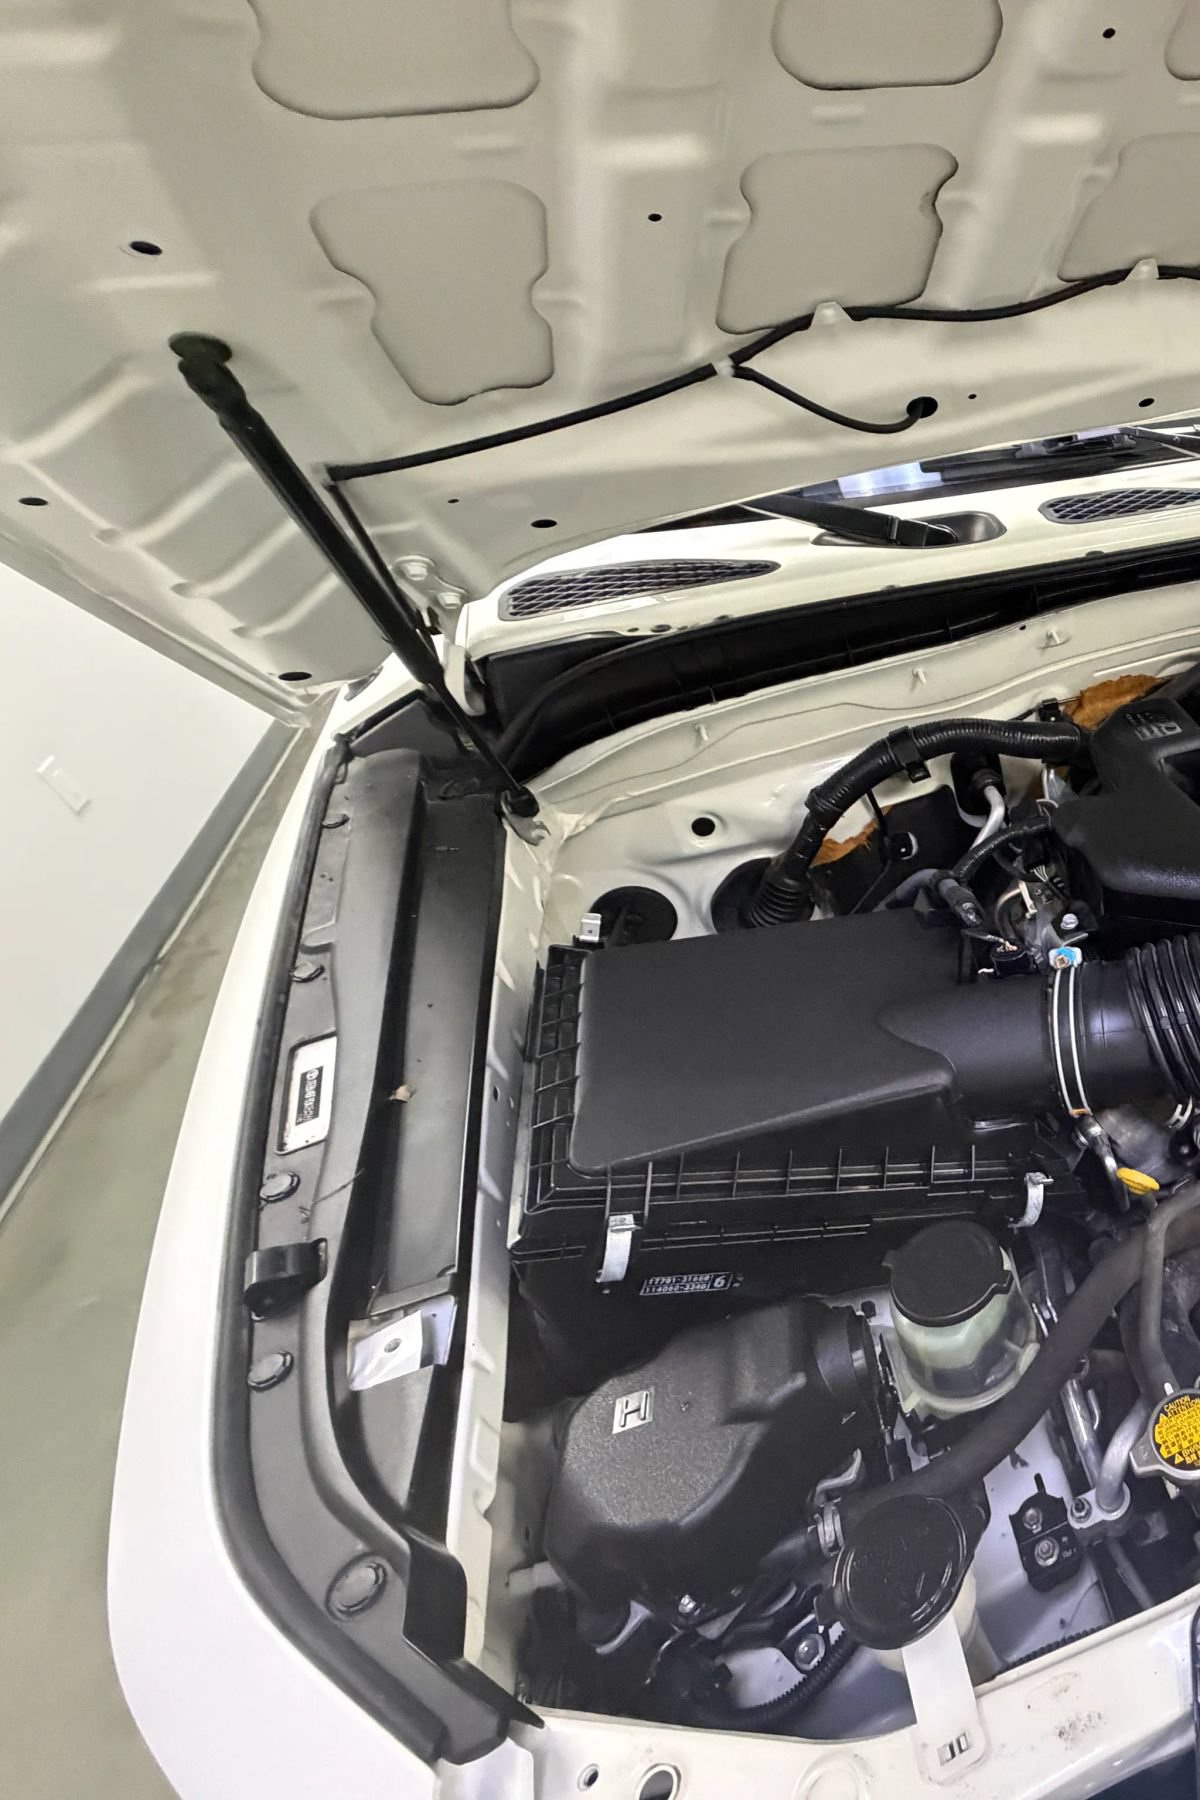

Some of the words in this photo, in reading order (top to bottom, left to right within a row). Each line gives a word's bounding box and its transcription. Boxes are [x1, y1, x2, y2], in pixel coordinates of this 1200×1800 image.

[713, 1275, 727, 1288] 6
[1164, 1395, 1190, 1412] CAUTION
[1167, 1398, 1200, 1418] ATTENTION
